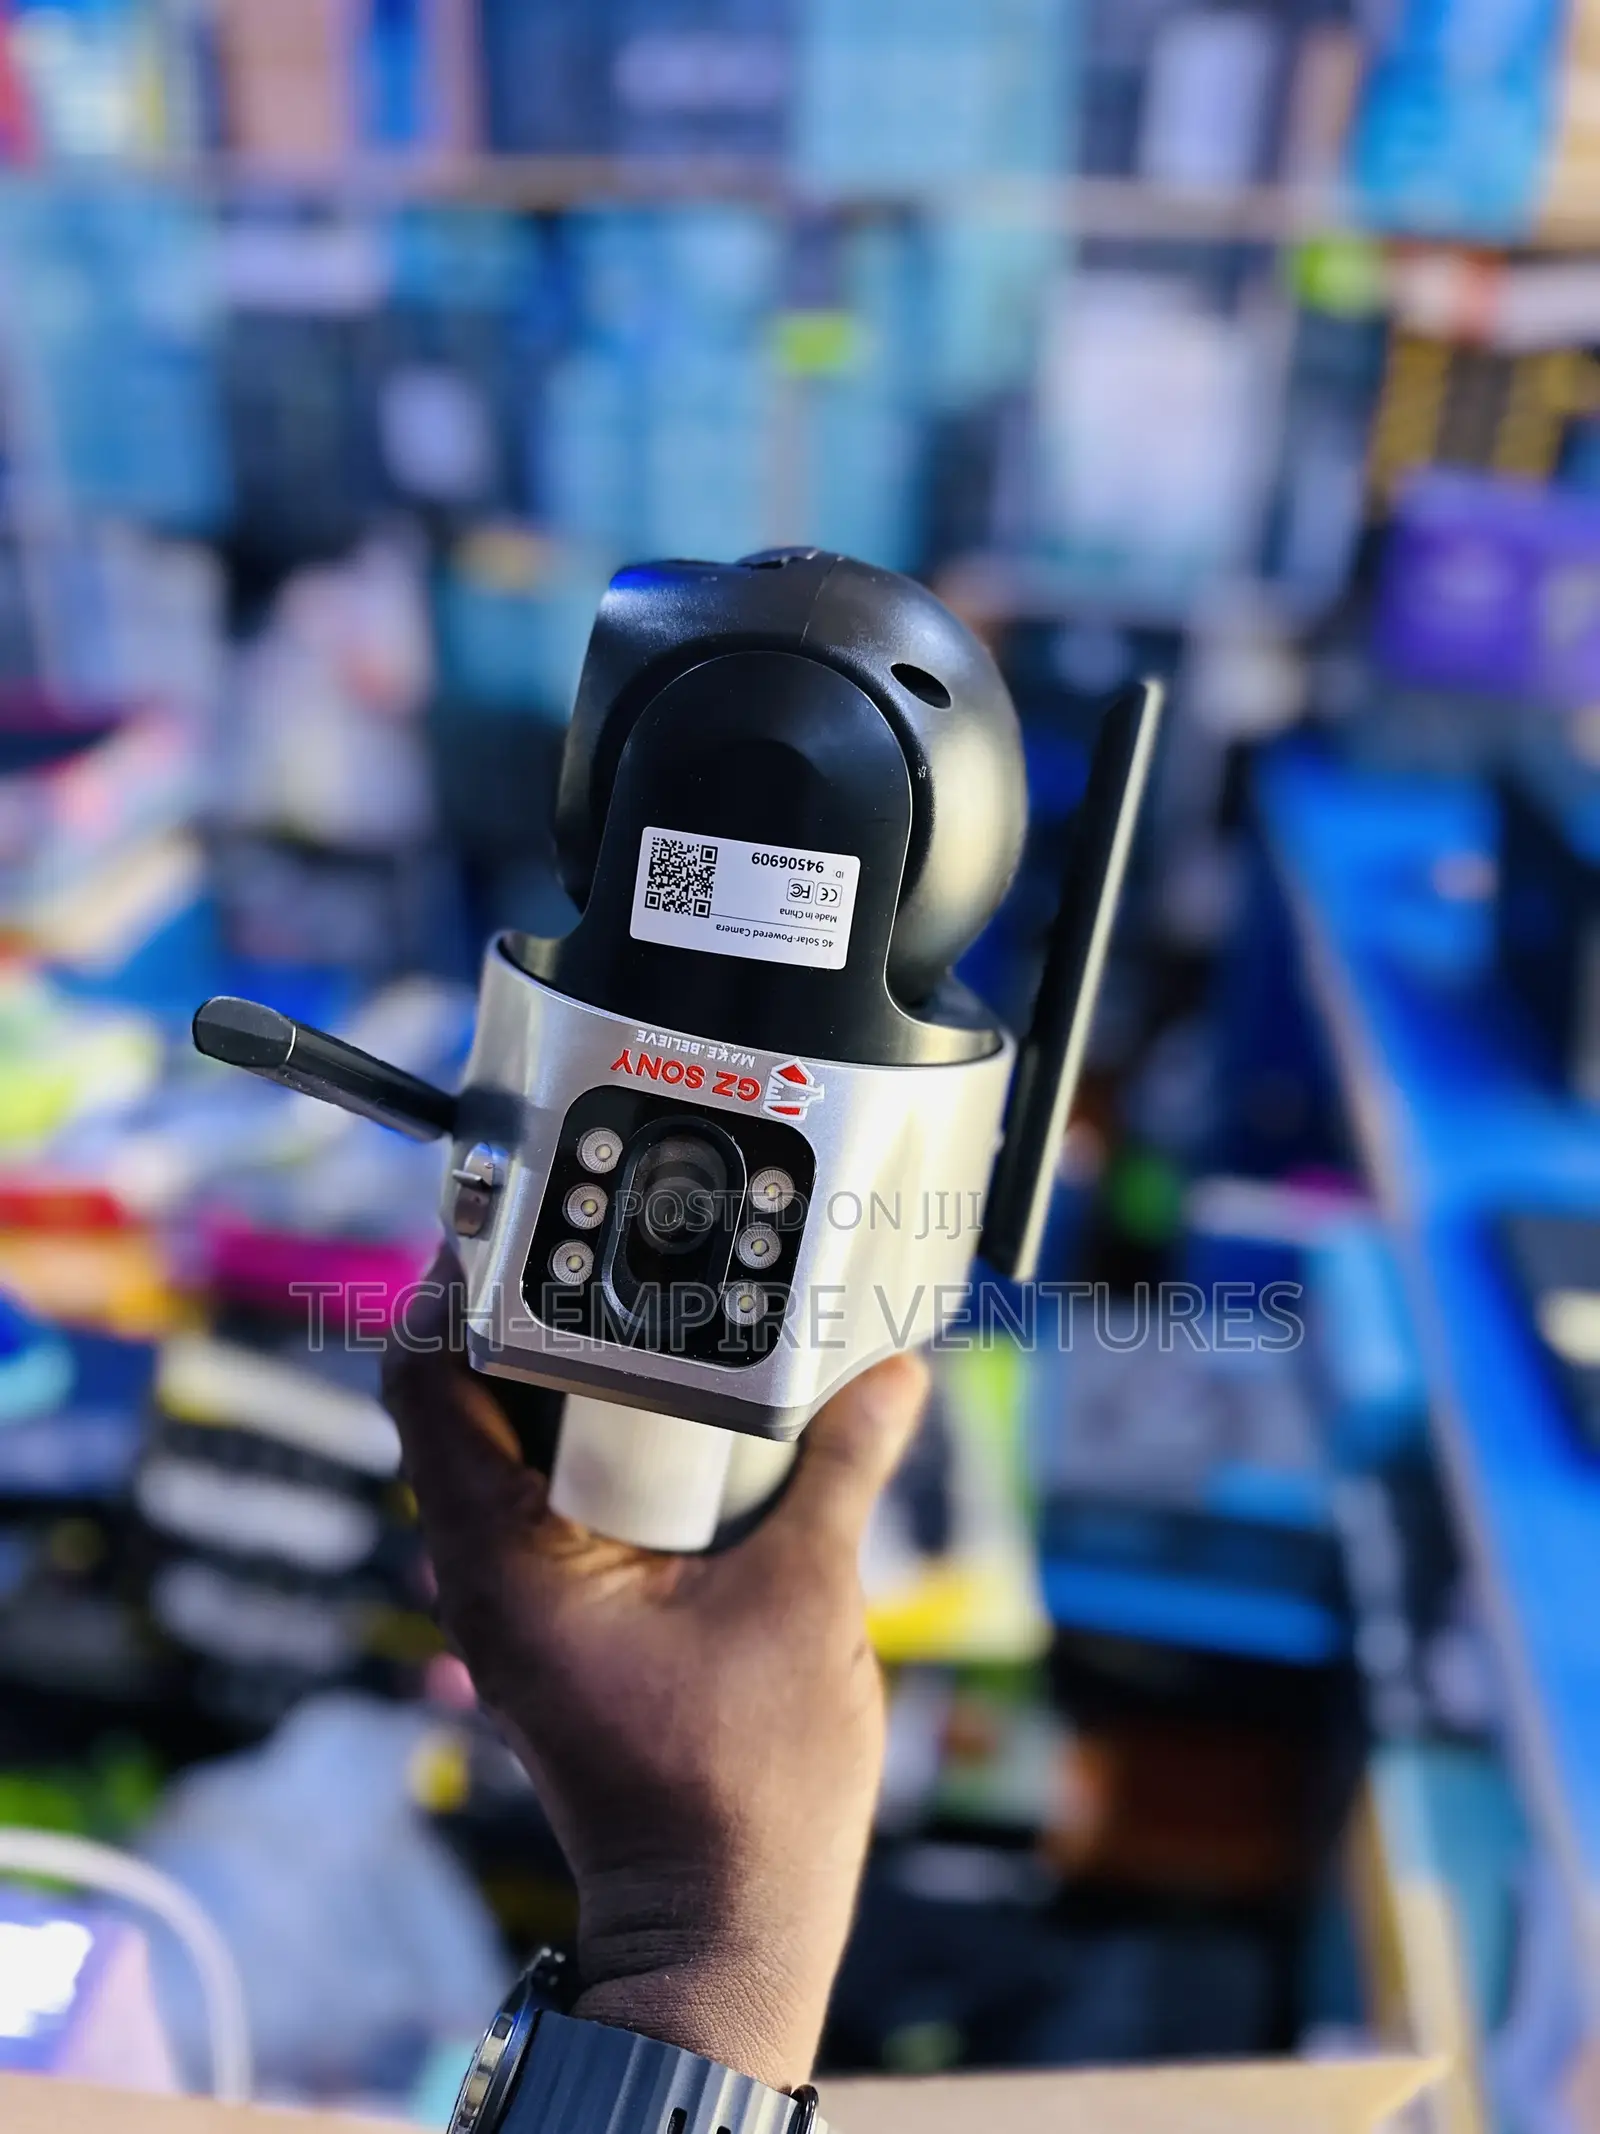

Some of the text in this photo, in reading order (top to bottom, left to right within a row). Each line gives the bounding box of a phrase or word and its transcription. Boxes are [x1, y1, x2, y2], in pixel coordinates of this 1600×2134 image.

[751, 852, 825, 874] 94506909
[779, 908, 837, 923] Made In China
[716, 924, 834, 948] 4G Solar-Powered Camera
[610, 1048, 762, 1102] GZ SONY
